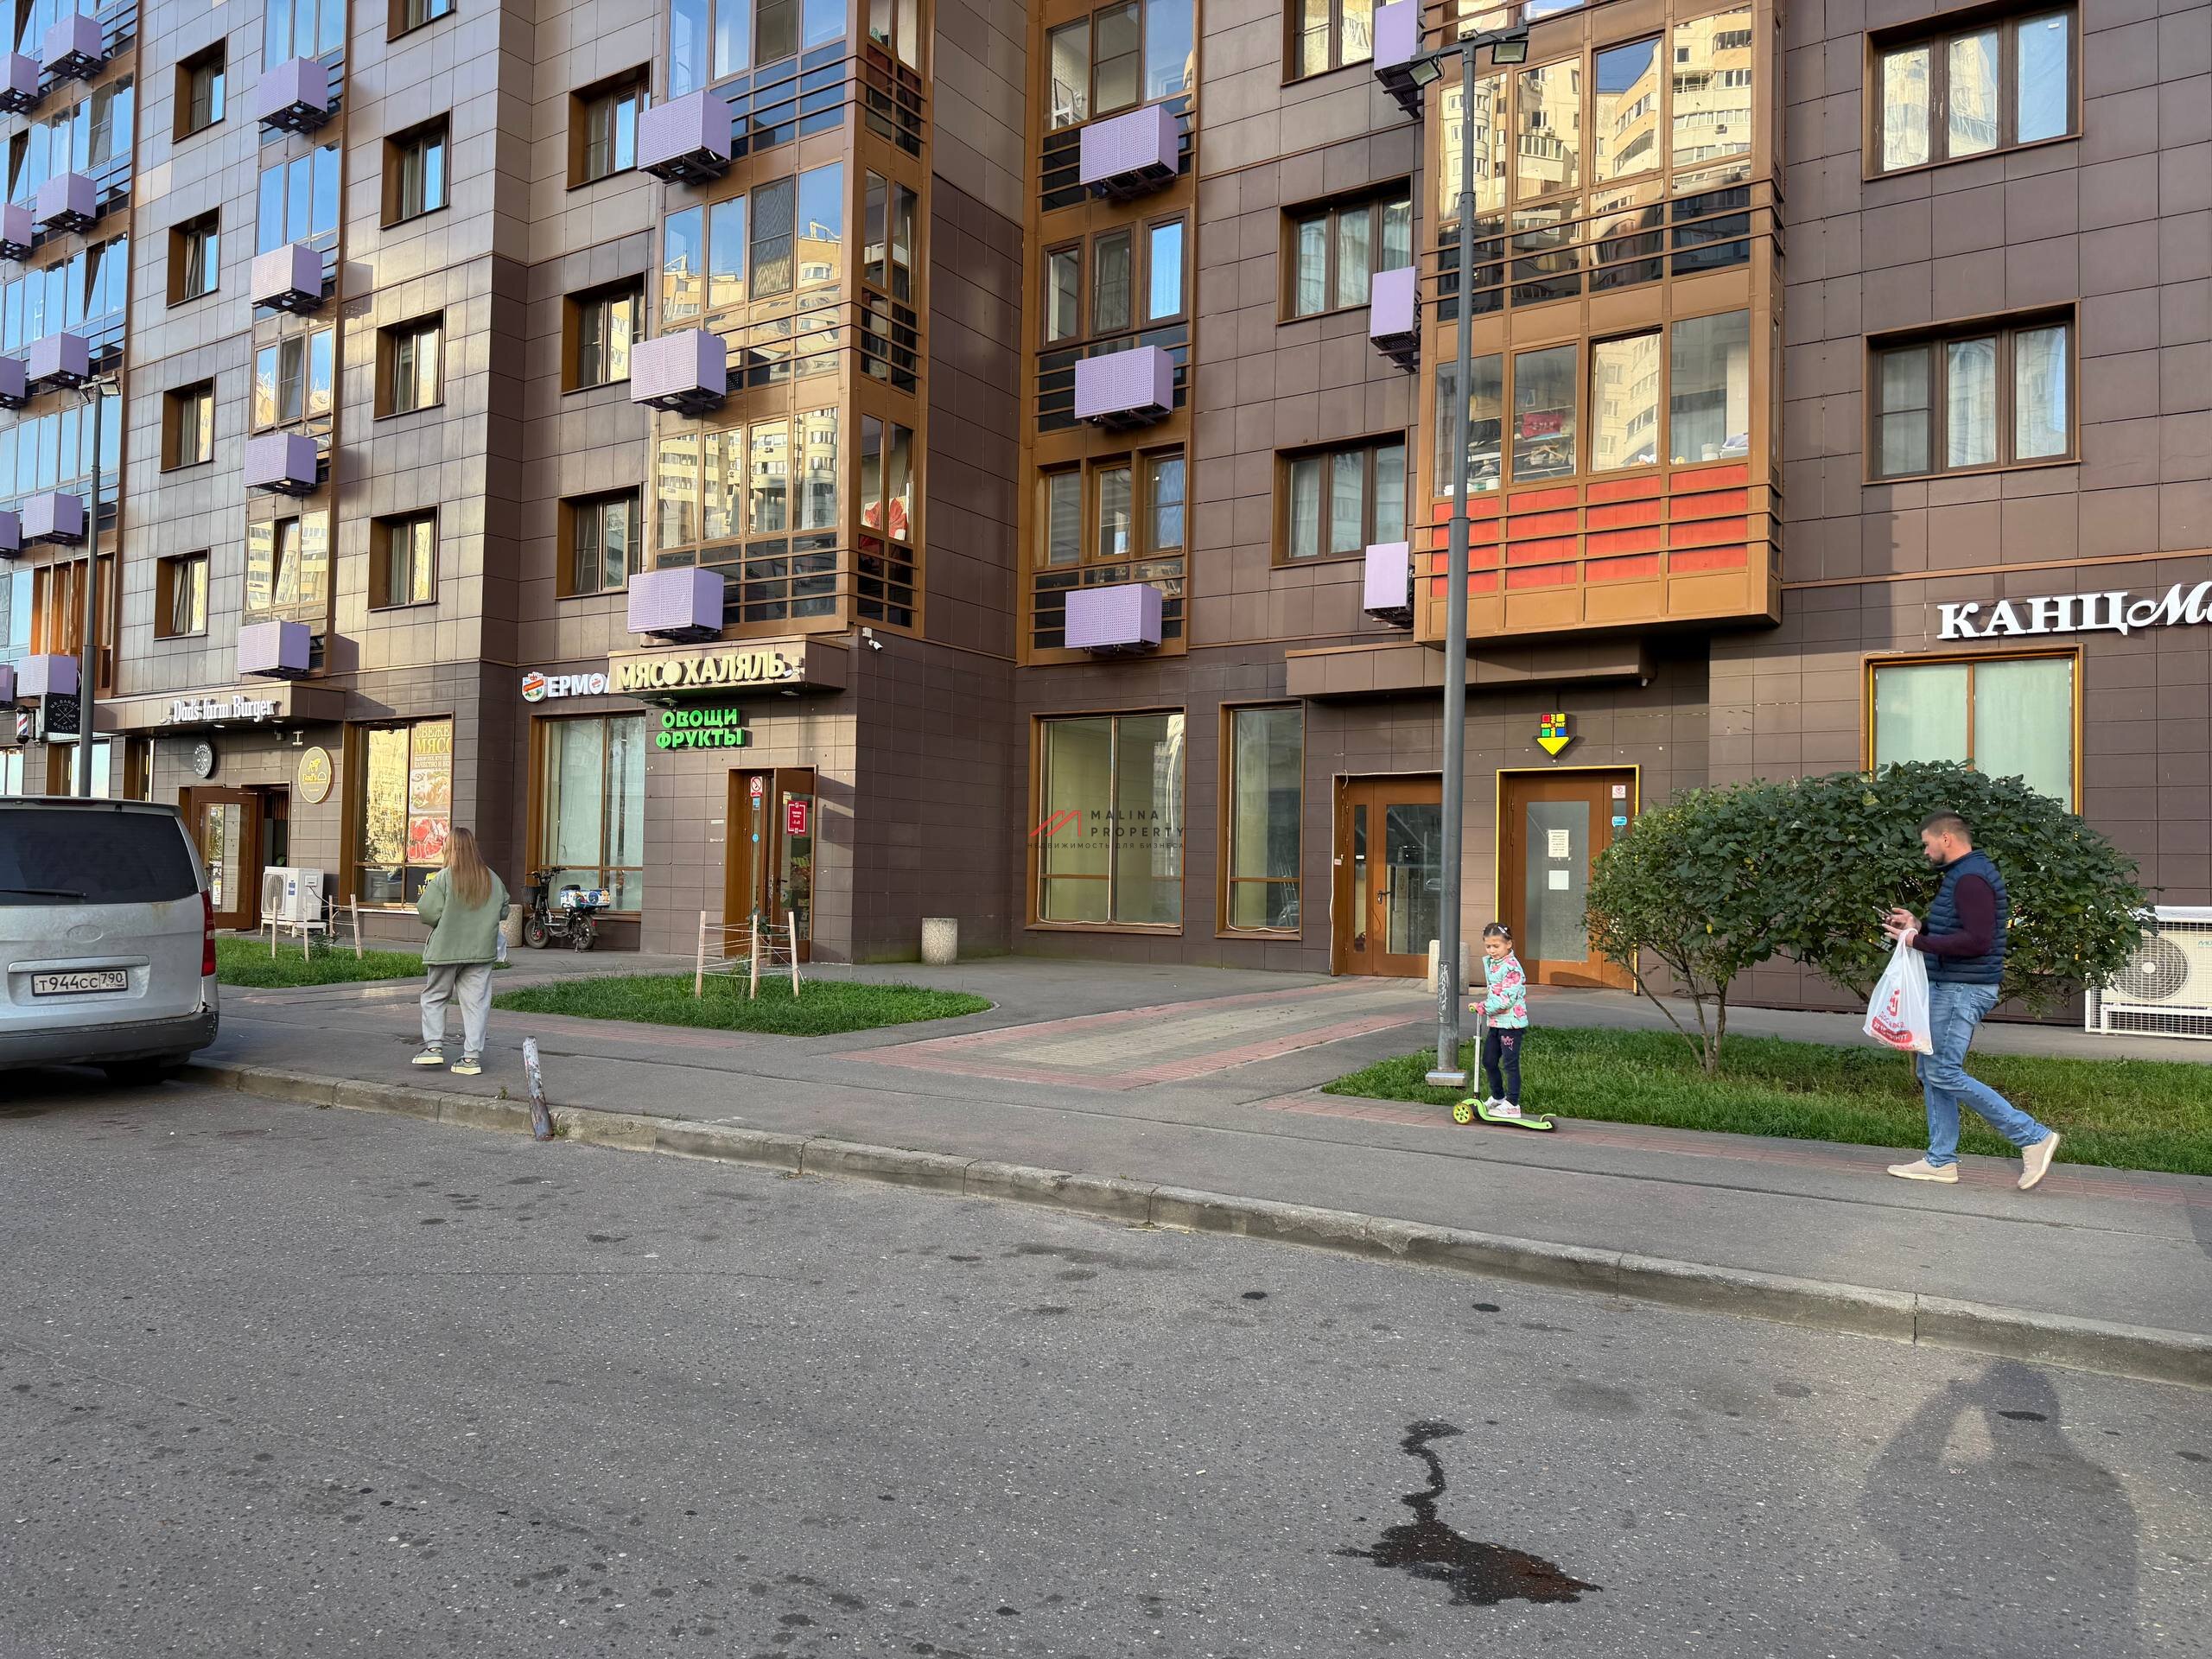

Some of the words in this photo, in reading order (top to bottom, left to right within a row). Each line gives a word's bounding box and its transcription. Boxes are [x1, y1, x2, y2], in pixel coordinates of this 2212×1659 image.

[616, 660, 683, 690] МЯСО
[683, 651, 785, 684] ХАЛЯЛЬ
[232, 695, 276, 723] Burger
[661, 709, 741, 728] ОВОЩИ
[655, 728, 746, 749] ФРУКТЫ
[100, 972, 124, 984] 790
